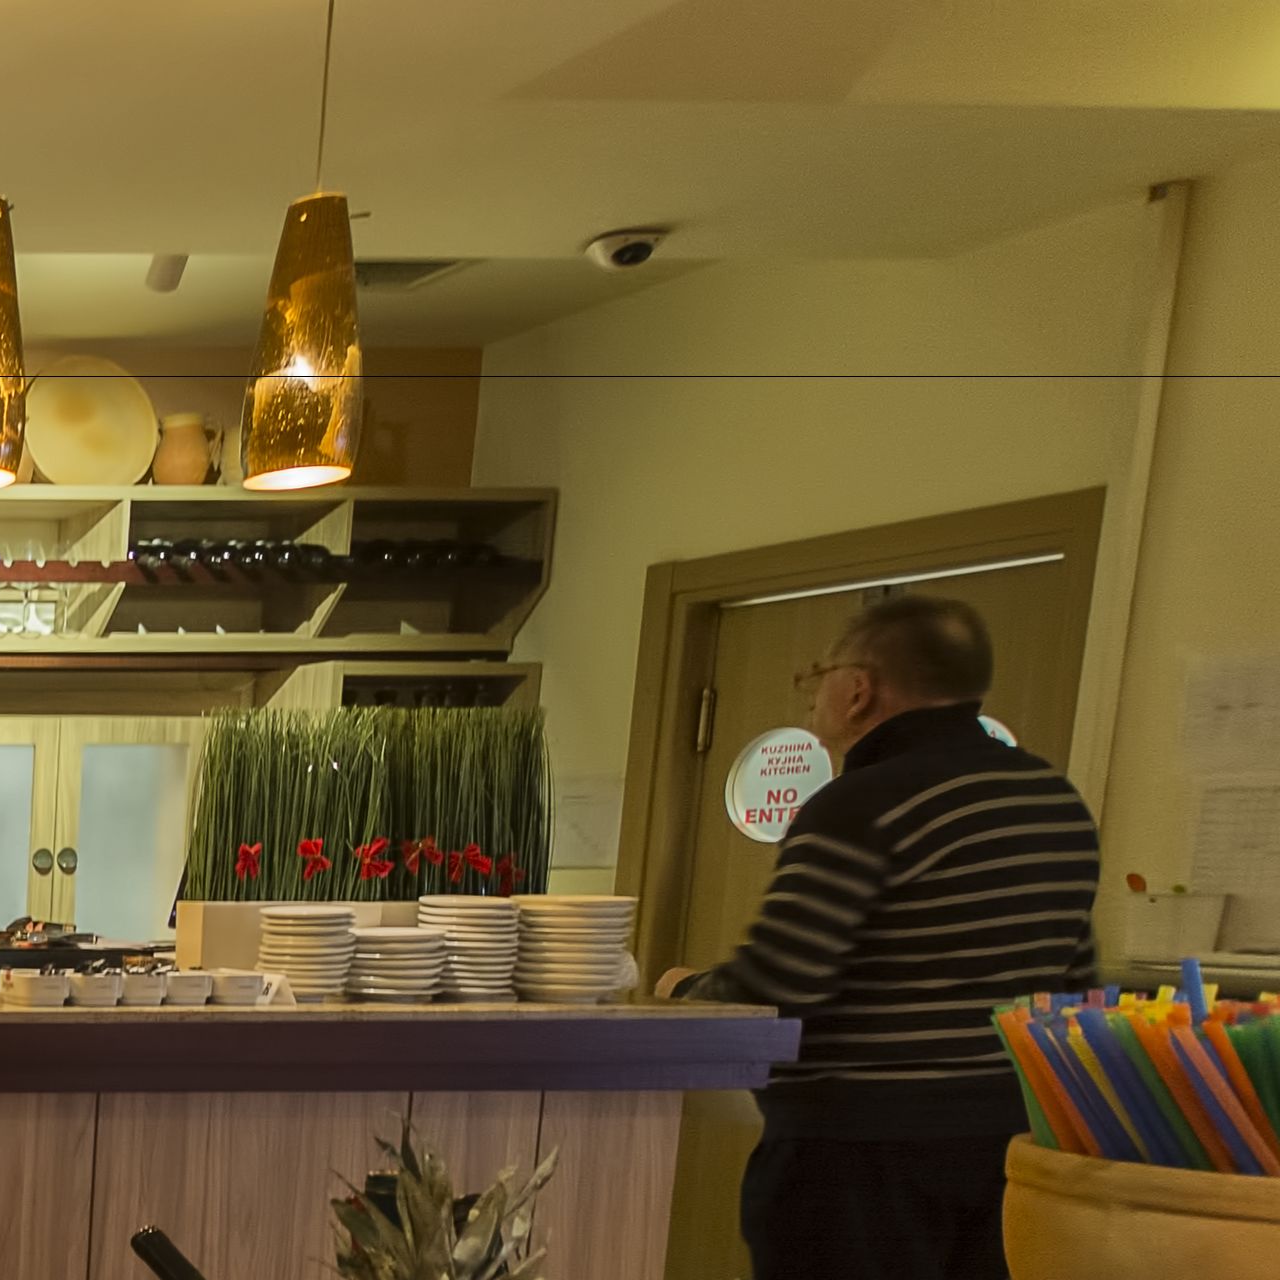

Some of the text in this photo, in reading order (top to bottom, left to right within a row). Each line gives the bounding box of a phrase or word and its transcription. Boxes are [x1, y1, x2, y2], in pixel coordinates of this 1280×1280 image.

[761, 742, 813, 755] KUZHINA
[760, 765, 811, 777] KITCHEN
[766, 788, 798, 805] NO
[744, 805, 801, 824] ENTE
